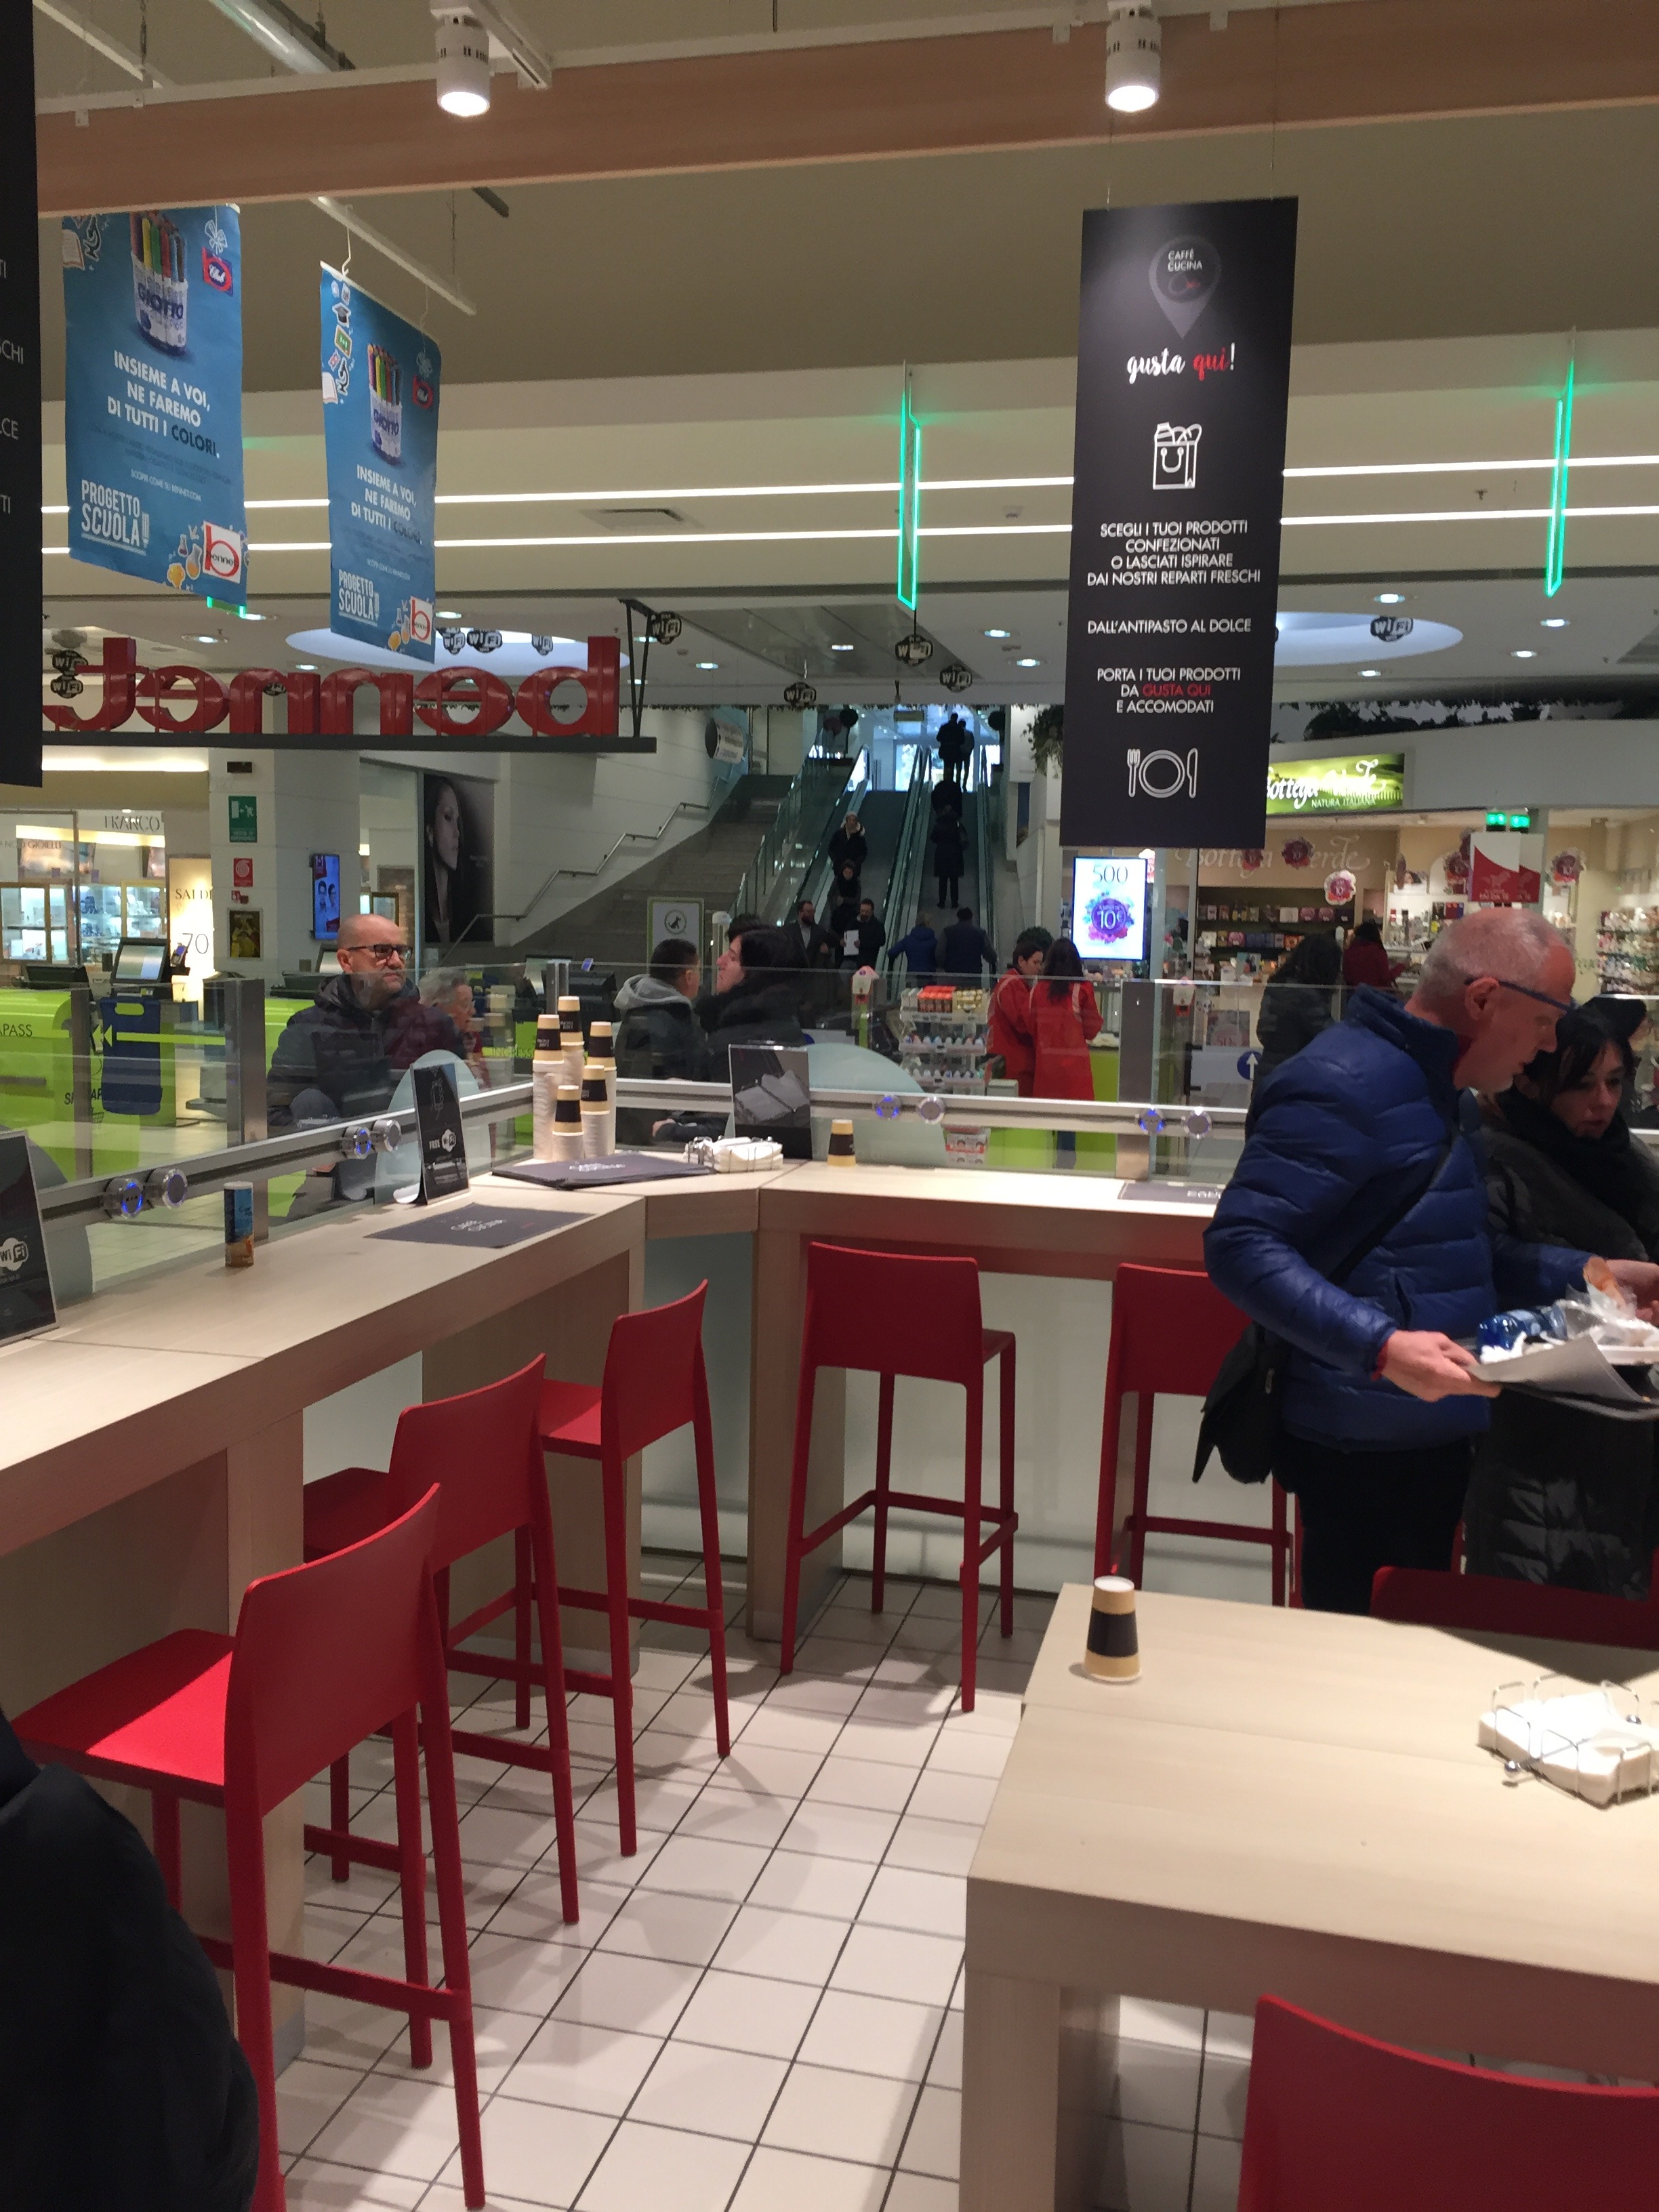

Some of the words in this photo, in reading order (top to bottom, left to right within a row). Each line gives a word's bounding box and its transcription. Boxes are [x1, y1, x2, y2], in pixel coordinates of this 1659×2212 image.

[1168, 260, 1203, 272] CUCINA
[1127, 348, 1185, 384] gusta
[114, 350, 167, 390] INSIEME
[171, 377, 181, 396] A
[184, 382, 210, 412] VOI,
[127, 380, 144, 404] NE
[149, 390, 201, 428] FAREMO
[108, 396, 121, 418] DI
[125, 403, 159, 434] TUTTI
[163, 419, 167, 437] I
[171, 424, 220, 459] COLORI.
[357, 464, 391, 493] INSIEME
[392, 483, 398, 497] A
[81, 479, 140, 518] PROGETTO
[365, 488, 377, 506] NE
[380, 494, 411, 521] FAREMO
[351, 501, 361, 518] DI
[363, 506, 386, 529] TUTTI
[388, 517, 391, 531] I
[1101, 523, 1142, 538] SCEGLI
[1145, 522, 1149, 536] I
[1152, 521, 1182, 536] TUOI
[1186, 519, 1248, 535] PRODOTTI
[1126, 537, 1220, 553] CONFEZIONATI
[1111, 555, 1123, 570] O
[1126, 554, 1177, 569] LASCIATI
[1181, 552, 1233, 569] ISPIRARE
[339, 569, 373, 598] PROGETTO
[1087, 572, 1108, 586] DAI
[1112, 571, 1157, 586] NOSTRI
[1161, 570, 1207, 585] REPARTI
[1210, 569, 1261, 583] FRESCHI
[1088, 619, 1187, 634] DALL'ANTIPASTO
[1191, 619, 1206, 634] AL
[1209, 617, 1251, 633] DOLCE
[1097, 667, 1136, 682] PORTA
[1139, 668, 1143, 682] I
[1146, 667, 1176, 682] TUOI
[1179, 667, 1241, 682] PRODOTTI
[1121, 684, 1139, 697] DA
[1142, 683, 1184, 697] GUSTA
[1187, 683, 1212, 697] QUI
[1116, 699, 1124, 714] E
[1127, 699, 1214, 714] ACCOMODATI
[1311, 798, 1340, 808] NATURA
[1093, 864, 1128, 884] 500
[181, 933, 209, 955] 70
